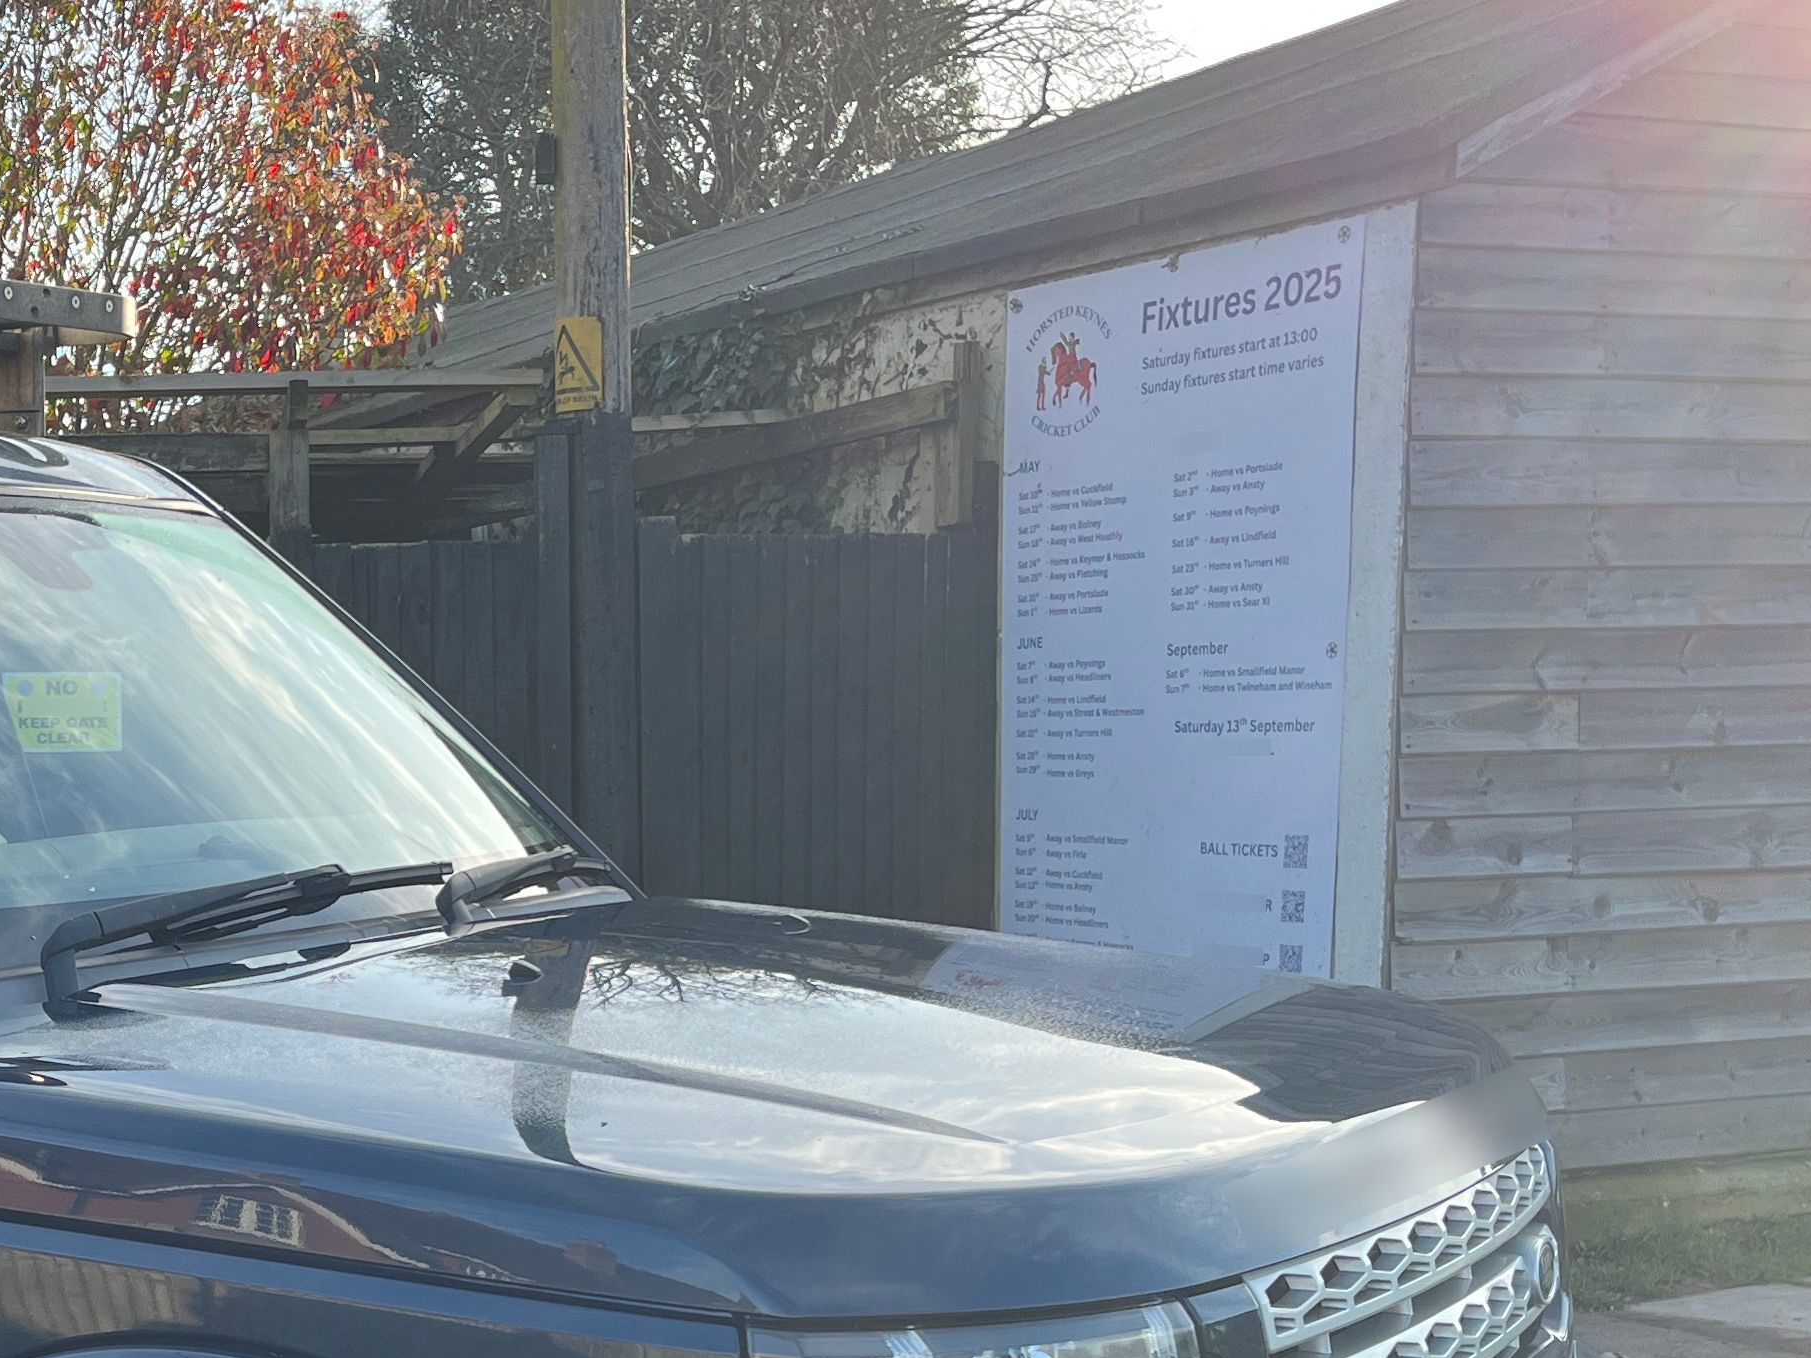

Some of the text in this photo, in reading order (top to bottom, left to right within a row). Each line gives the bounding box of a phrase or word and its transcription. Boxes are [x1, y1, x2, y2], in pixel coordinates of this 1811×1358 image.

[1141, 263, 1342, 334] Fixtures 2025
[1026, 305, 1113, 353] HORSTED KEYNES
[1141, 327, 1318, 371] Saturday fixtures start at 13:00
[1140, 353, 1325, 396] Sunday fixtures start time varies
[1032, 405, 1100, 438] CRICKET CLUB
[1019, 460, 1041, 474] MAY
[1174, 472, 1185, 483] Sat
[1211, 467, 1233, 478] Home
[1245, 461, 1283, 474] Portslade
[1173, 488, 1187, 498] Sun
[1211, 484, 1230, 495] Away
[1243, 480, 1266, 492] Ansty
[1173, 511, 1185, 522] Sat
[1210, 509, 1233, 518] Home
[1244, 503, 1280, 517] Poynings
[1172, 537, 1184, 548] Sat
[1209, 535, 1230, 546] Away
[1240, 529, 1277, 542] Lindfield
[1171, 564, 1184, 574] Sat
[1209, 560, 1231, 570] Home
[1171, 586, 1183, 597] Sat
[1208, 583, 1228, 595] Away
[1170, 601, 1184, 612] Sun
[1208, 600, 1230, 609] Home
[1016, 636, 1043, 650] JUNE
[1166, 641, 1229, 659] September
[1165, 669, 1179, 680] Sat
[1203, 668, 1226, 678] Home
[45, 680, 78, 696] NO
[1165, 684, 1179, 694] Sun
[1202, 683, 1226, 693] Home
[18, 716, 108, 729] KEEP GATE
[1174, 717, 1316, 736] Saturday 13th September
[36, 732, 90, 745] CLEAR
[1015, 808, 1039, 821] JULY
[1200, 841, 1279, 858] BALL TICKETS
